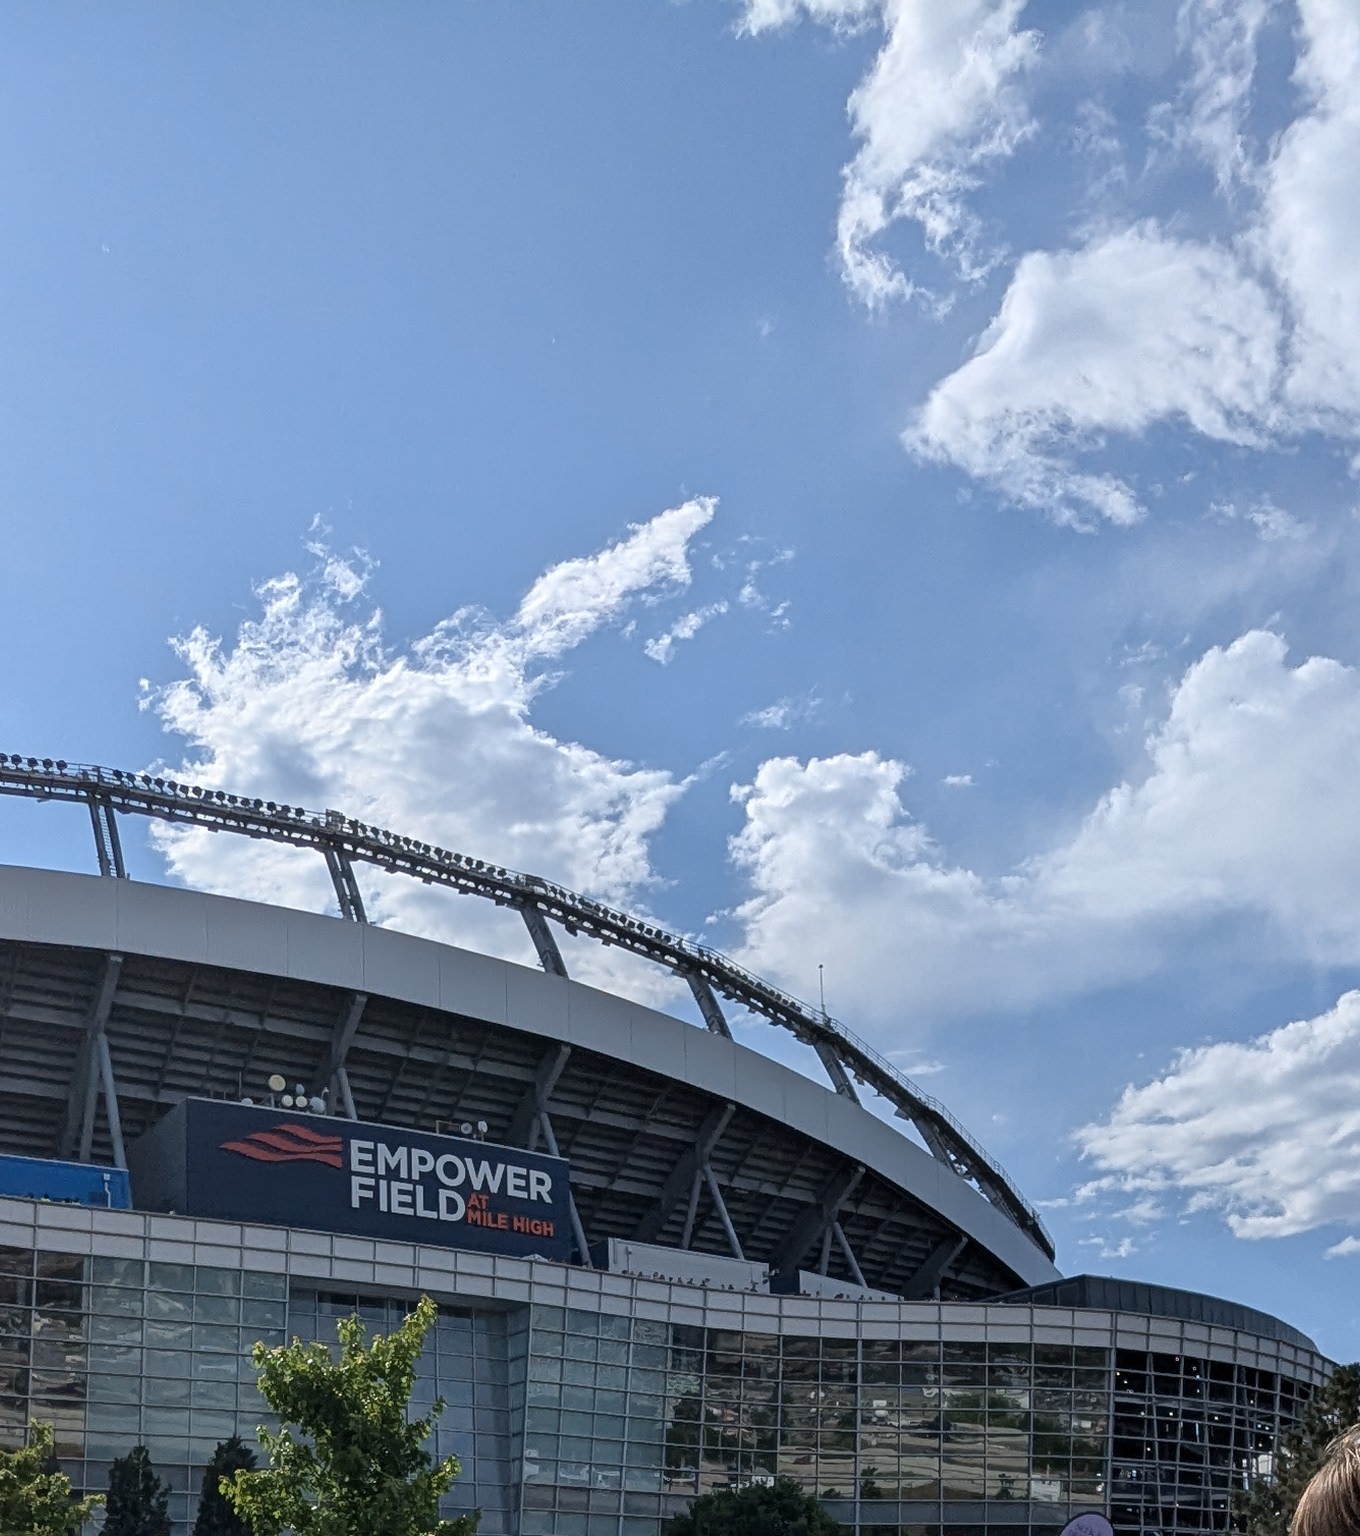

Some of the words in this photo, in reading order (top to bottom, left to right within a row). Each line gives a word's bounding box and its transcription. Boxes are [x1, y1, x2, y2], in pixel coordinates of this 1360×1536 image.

[349, 1138, 553, 1204] EMPOWER
[350, 1175, 466, 1222] FIELD
[466, 1192, 490, 1211] AT
[466, 1208, 509, 1230] MILE
[513, 1214, 555, 1238] HIGH
